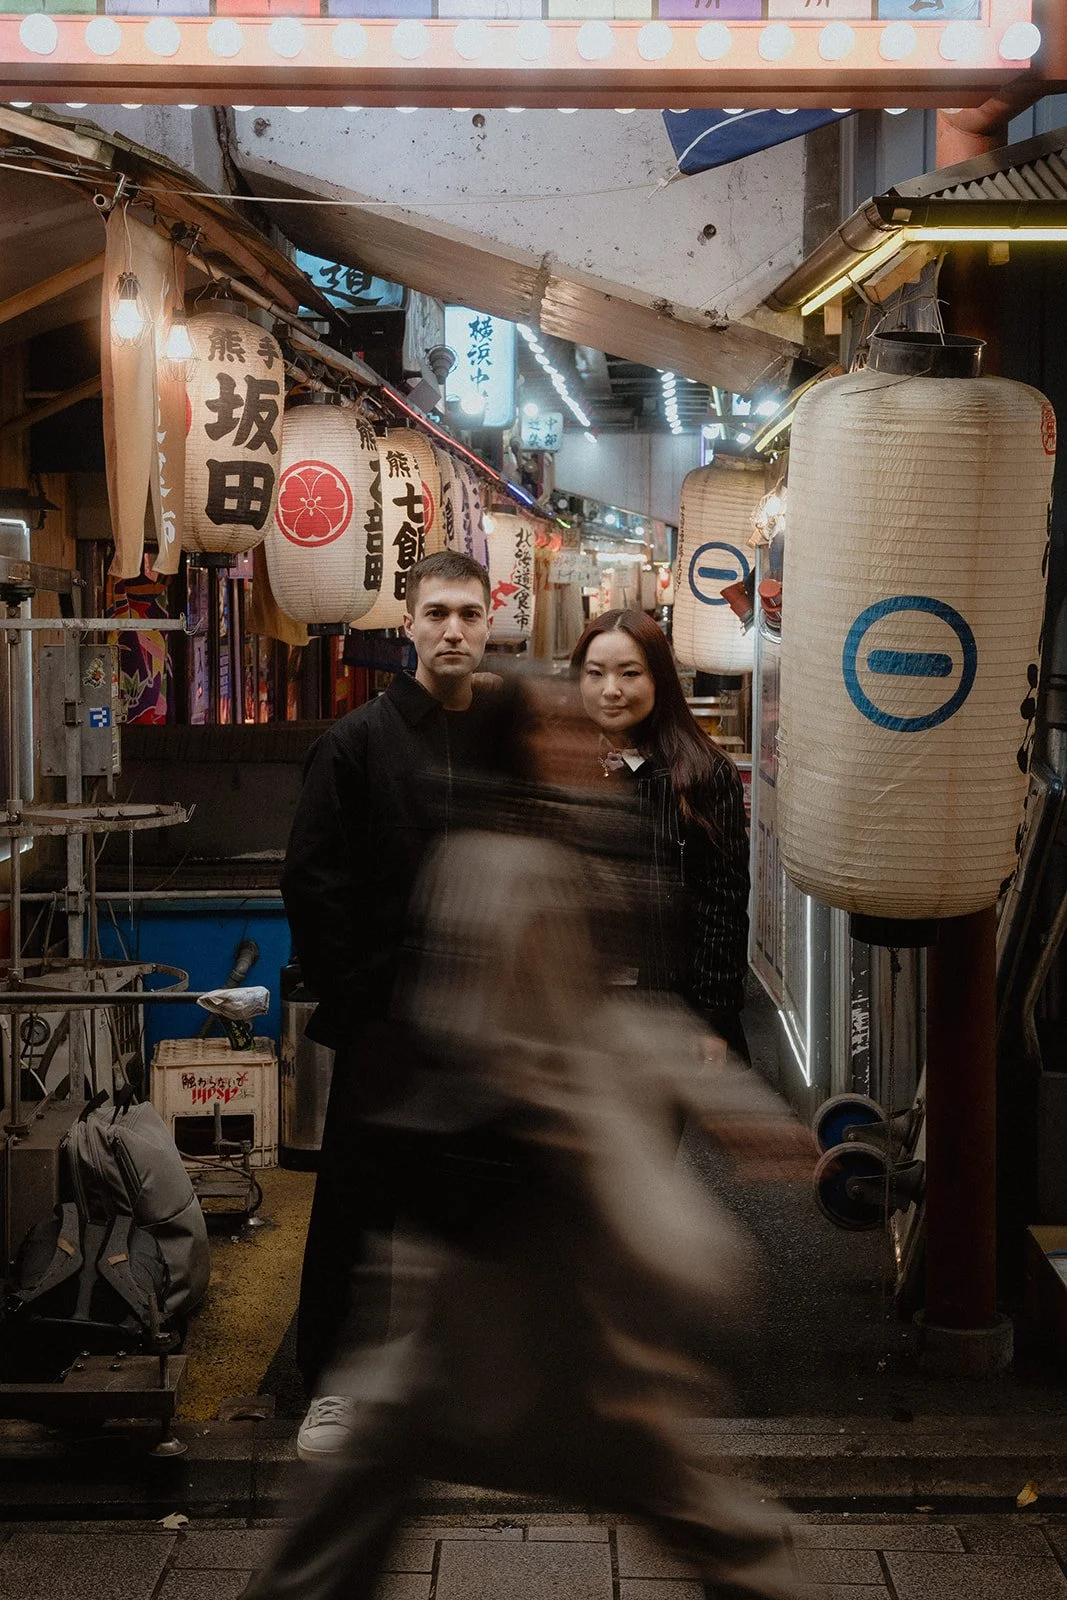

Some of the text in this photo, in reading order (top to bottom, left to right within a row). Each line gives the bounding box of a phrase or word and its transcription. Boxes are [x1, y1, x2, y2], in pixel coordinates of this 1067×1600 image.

[467, 316, 494, 410] 横浜中
[204, 372, 280, 531] 坂田
[513, 528, 533, 631] 北海道食市
[191, 1087, 238, 1104] Asahi
